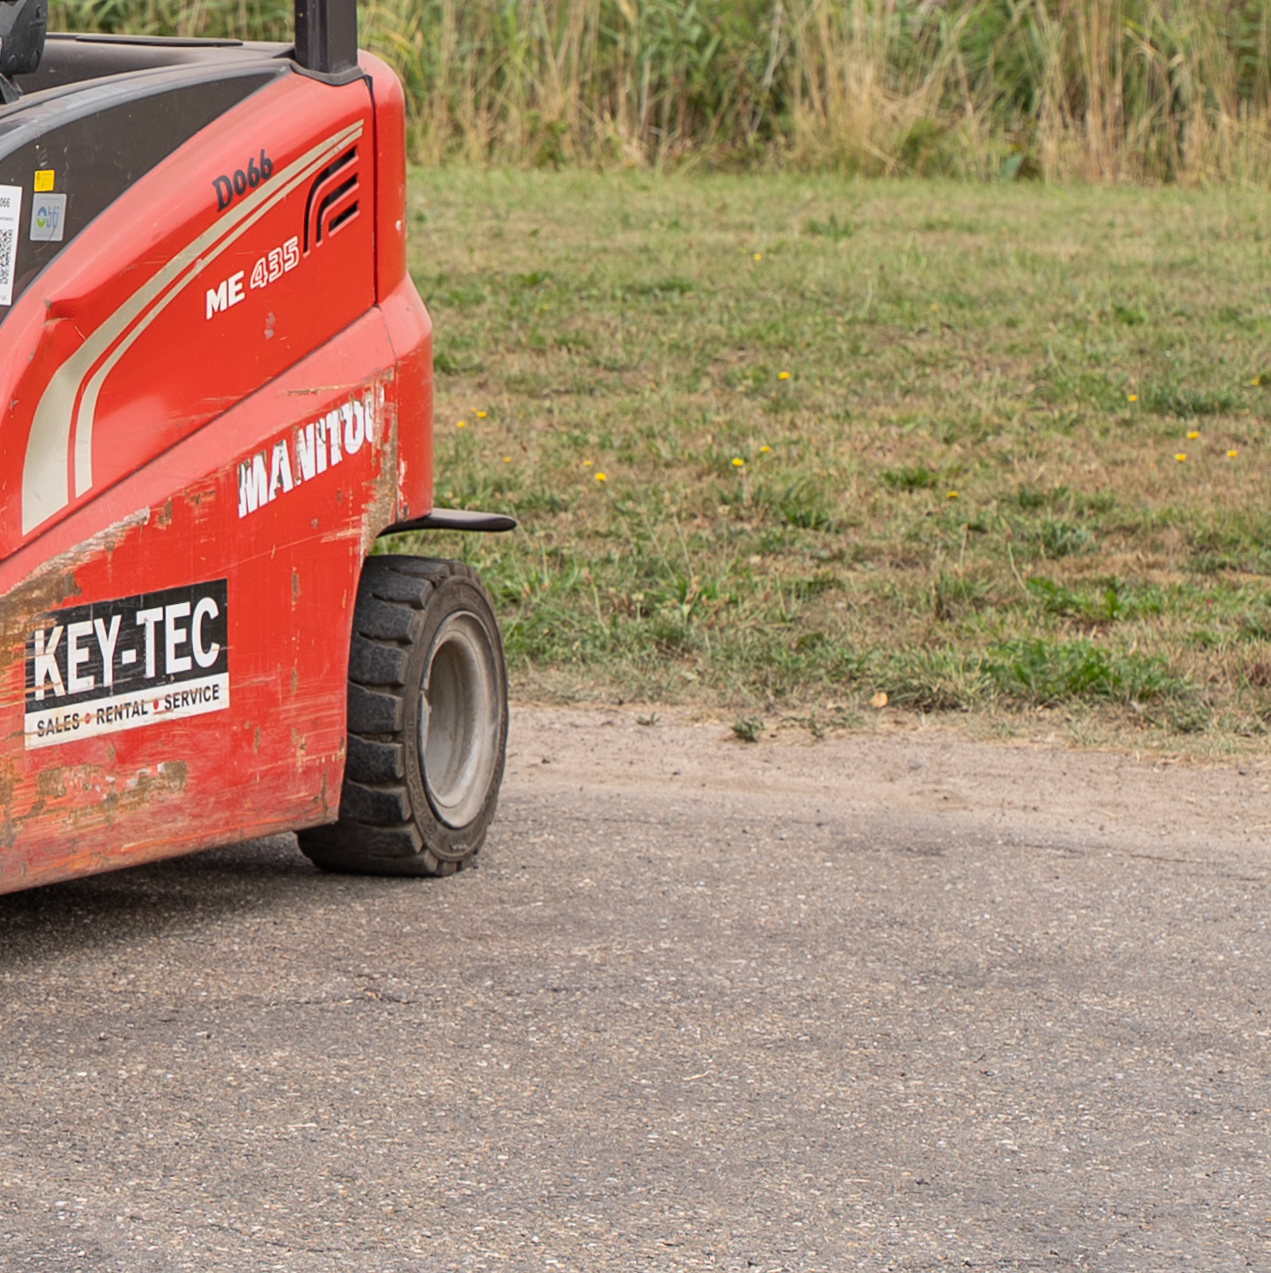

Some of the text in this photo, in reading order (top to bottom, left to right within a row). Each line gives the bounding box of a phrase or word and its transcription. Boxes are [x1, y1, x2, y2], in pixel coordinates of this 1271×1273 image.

[206, 236, 299, 320] ME 435
[34, 597, 220, 701] KEY-TEC
[37, 684, 219, 737] SALES RENTAL SERVICE
